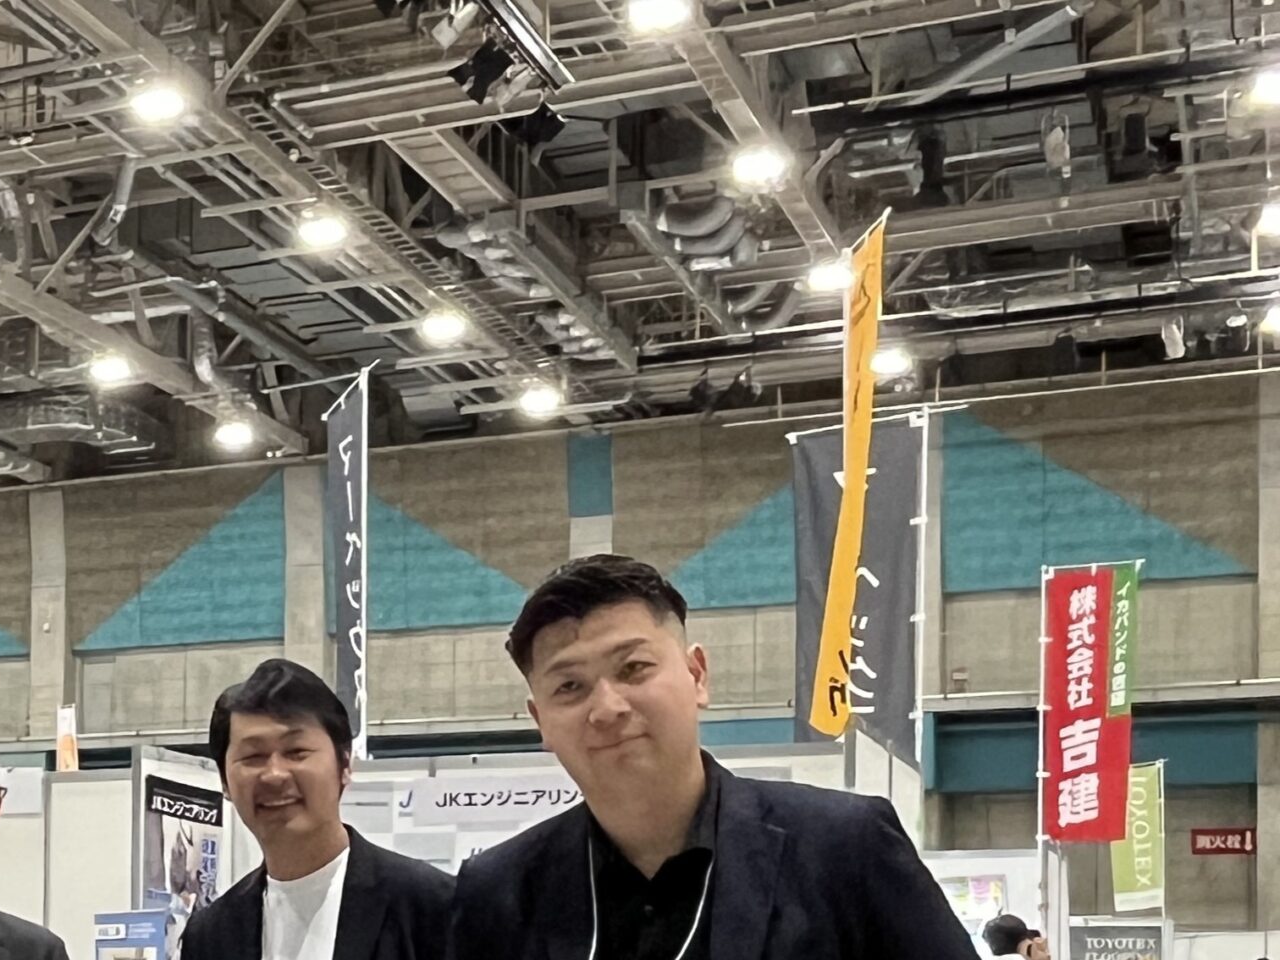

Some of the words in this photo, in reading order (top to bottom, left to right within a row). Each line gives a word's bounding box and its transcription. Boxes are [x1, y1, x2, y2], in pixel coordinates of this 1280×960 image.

[1066, 585, 1098, 711] 株式会社
[435, 789, 584, 808] JKエンジニアリン
[1085, 937, 1157, 950] TOYOTEX
